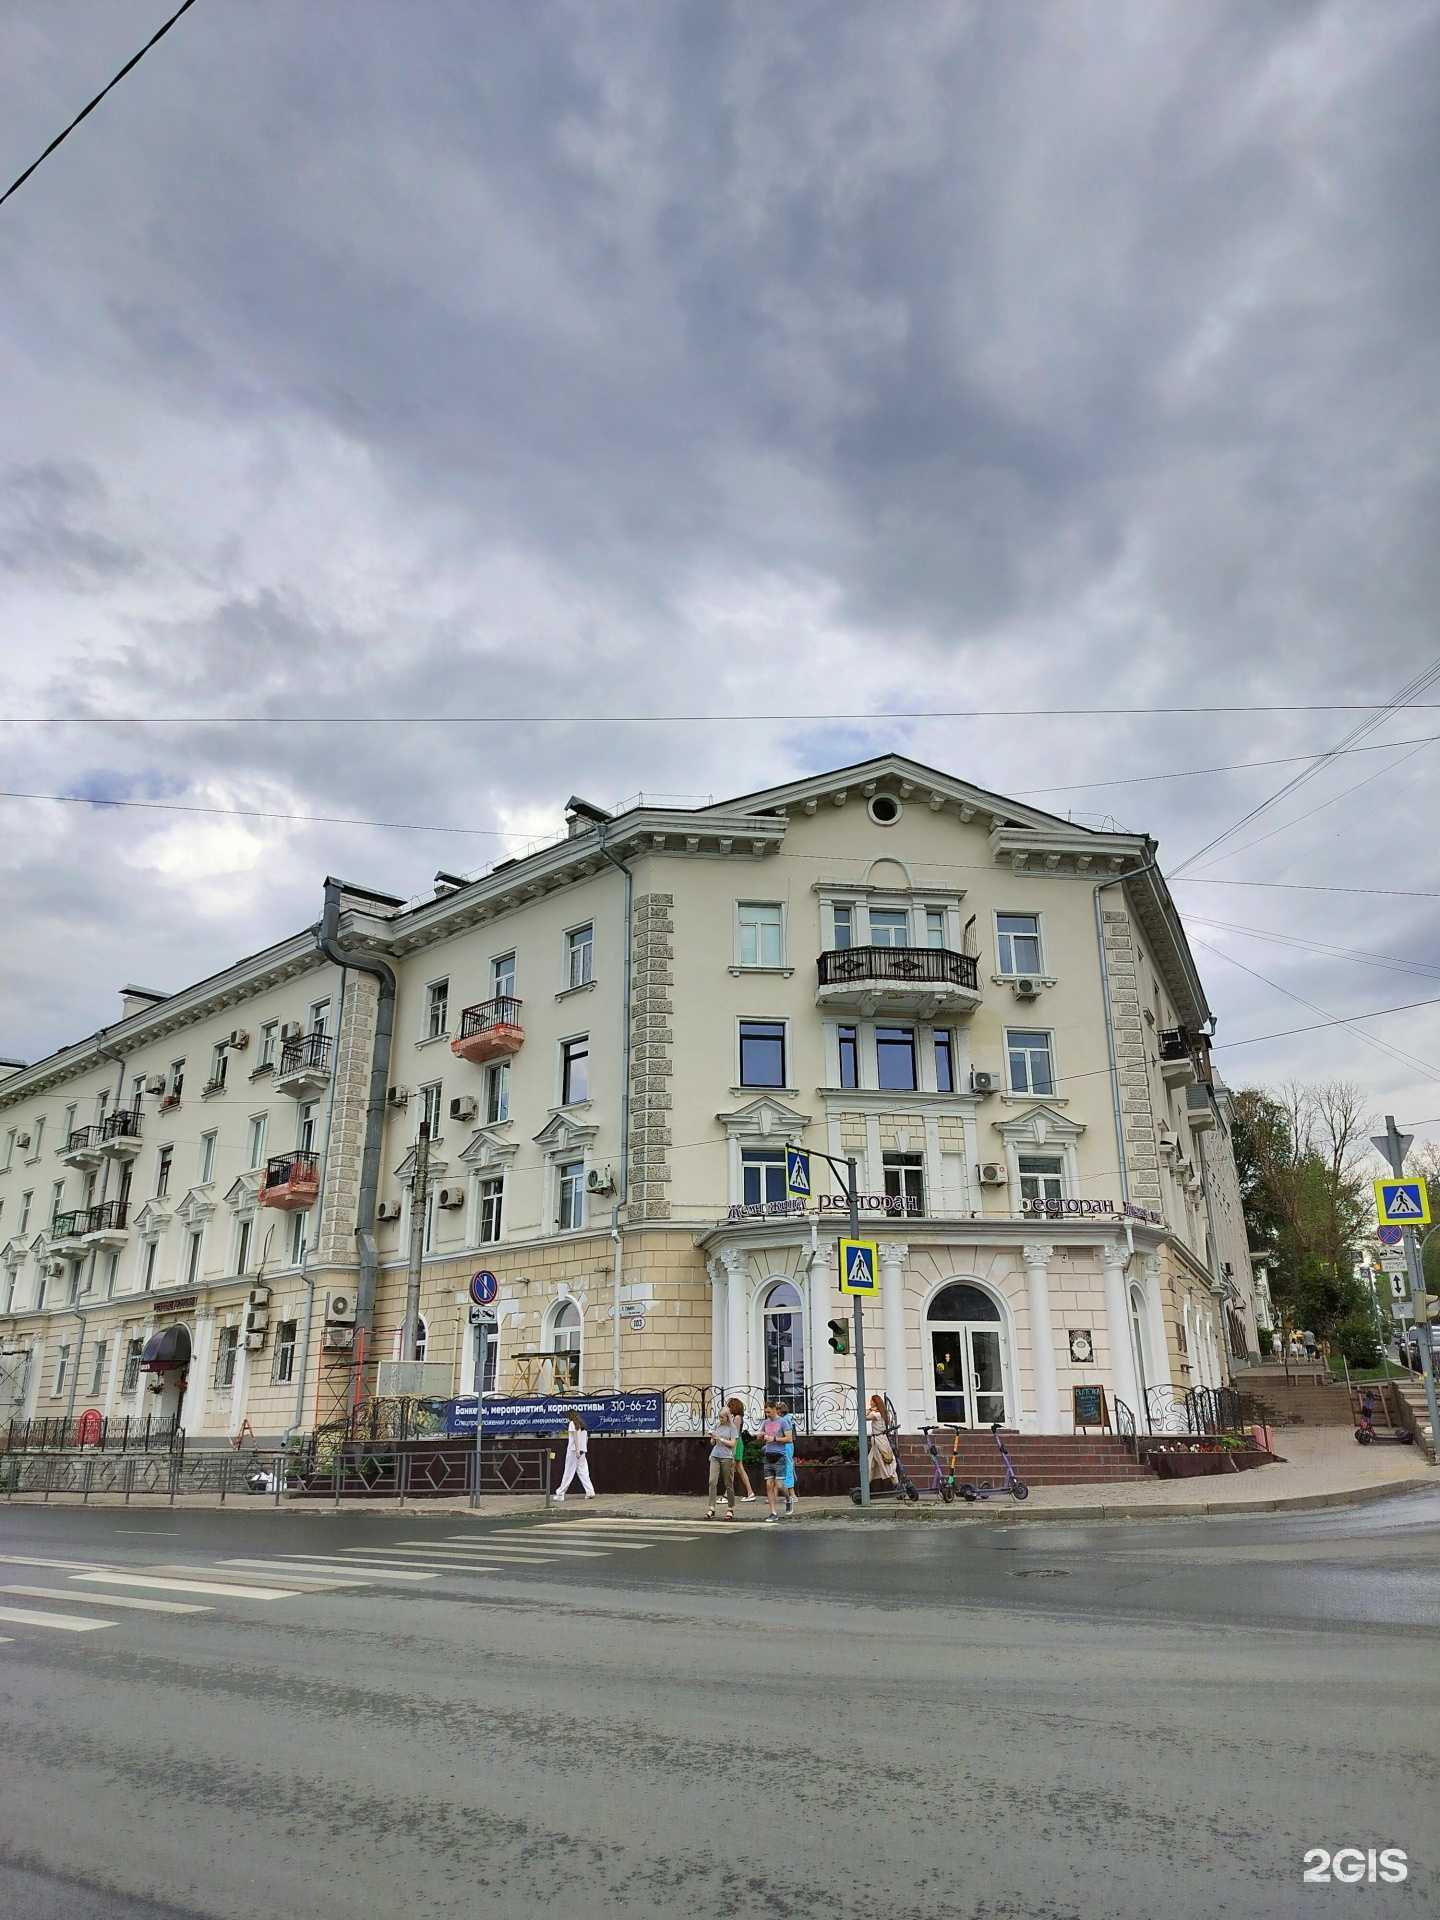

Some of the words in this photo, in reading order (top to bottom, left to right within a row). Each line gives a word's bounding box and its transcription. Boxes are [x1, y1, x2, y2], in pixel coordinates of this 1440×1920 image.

[1020, 1199, 1114, 1216] ресторан
[633, 1319, 643, 1327] 103
[455, 1405, 489, 1415] Банкеы,
[491, 1404, 546, 1416] мероприятия,
[547, 1403, 605, 1414] корпоративы
[611, 1400, 657, 1411] 310-66-23
